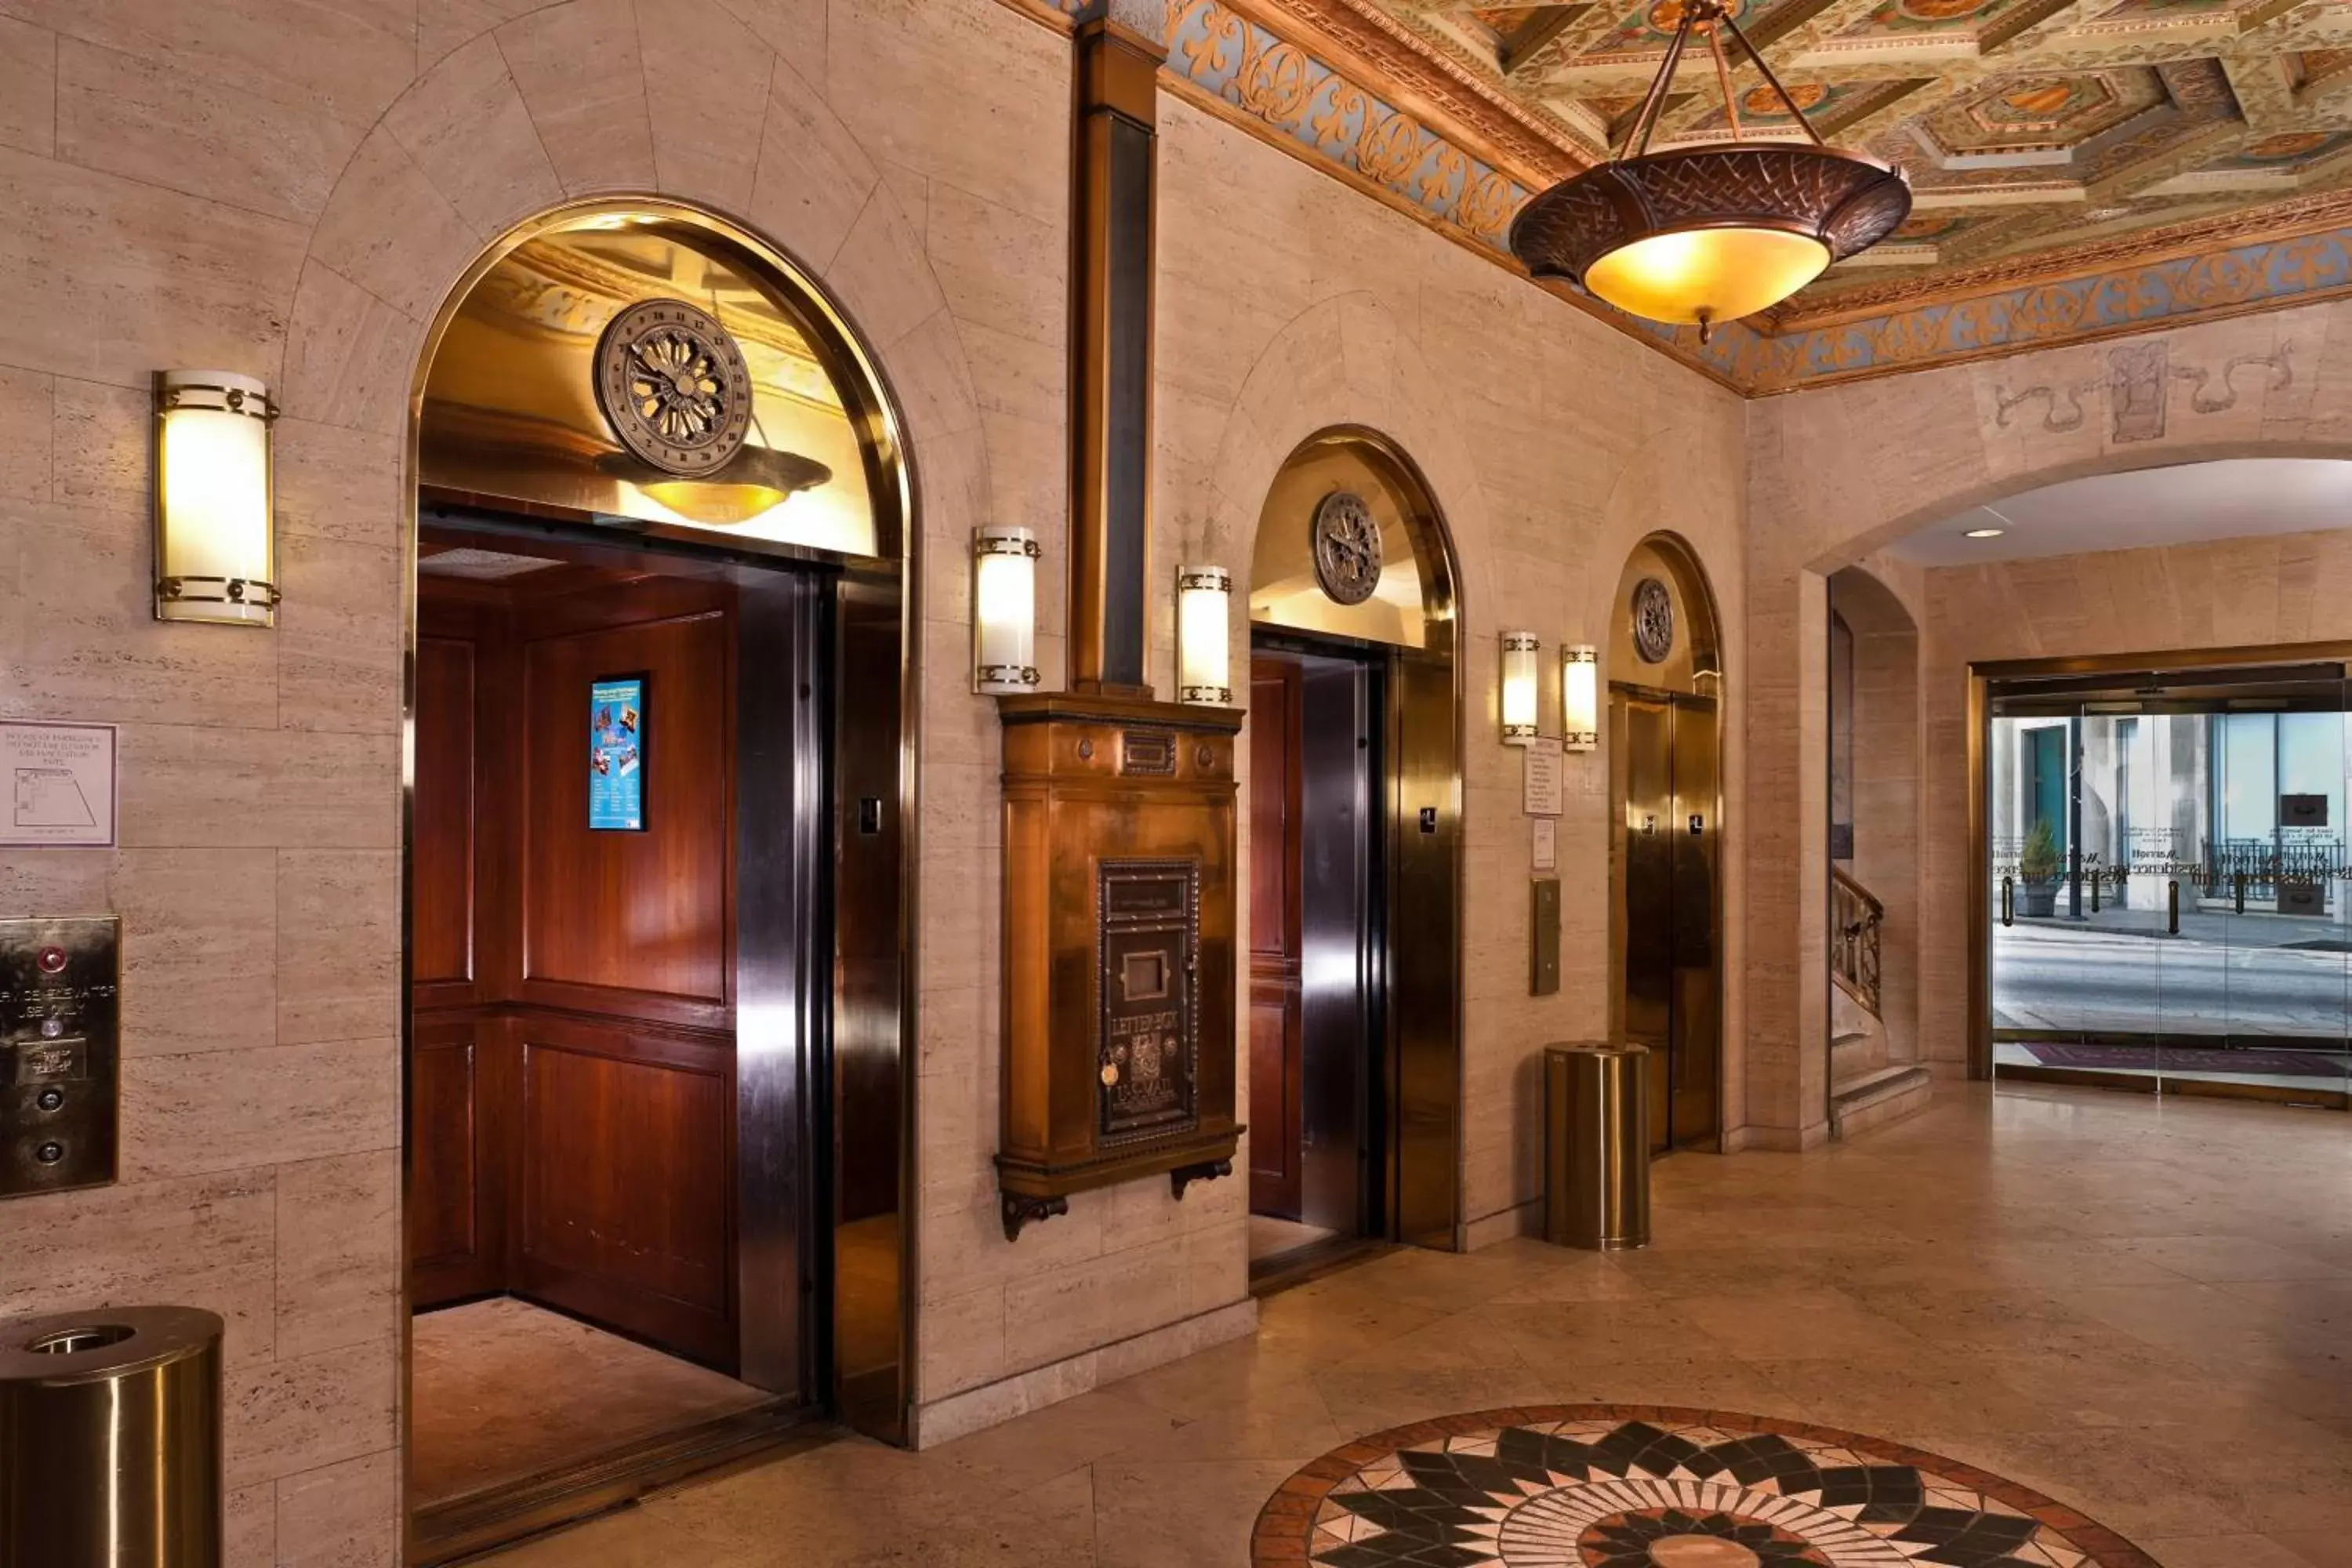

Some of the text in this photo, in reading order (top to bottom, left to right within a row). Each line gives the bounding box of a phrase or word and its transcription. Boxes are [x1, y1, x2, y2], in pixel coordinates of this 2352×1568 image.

[653, 310, 665, 321] 10
[676, 311, 685, 321] 11
[694, 319, 704, 330] 12
[613, 363, 621, 372] 6
[619, 404, 626, 413] 4
[734, 412, 744, 423] 17
[631, 423, 638, 433] 3
[646, 438, 652, 448] 2
[663, 449, 668, 459] 1
